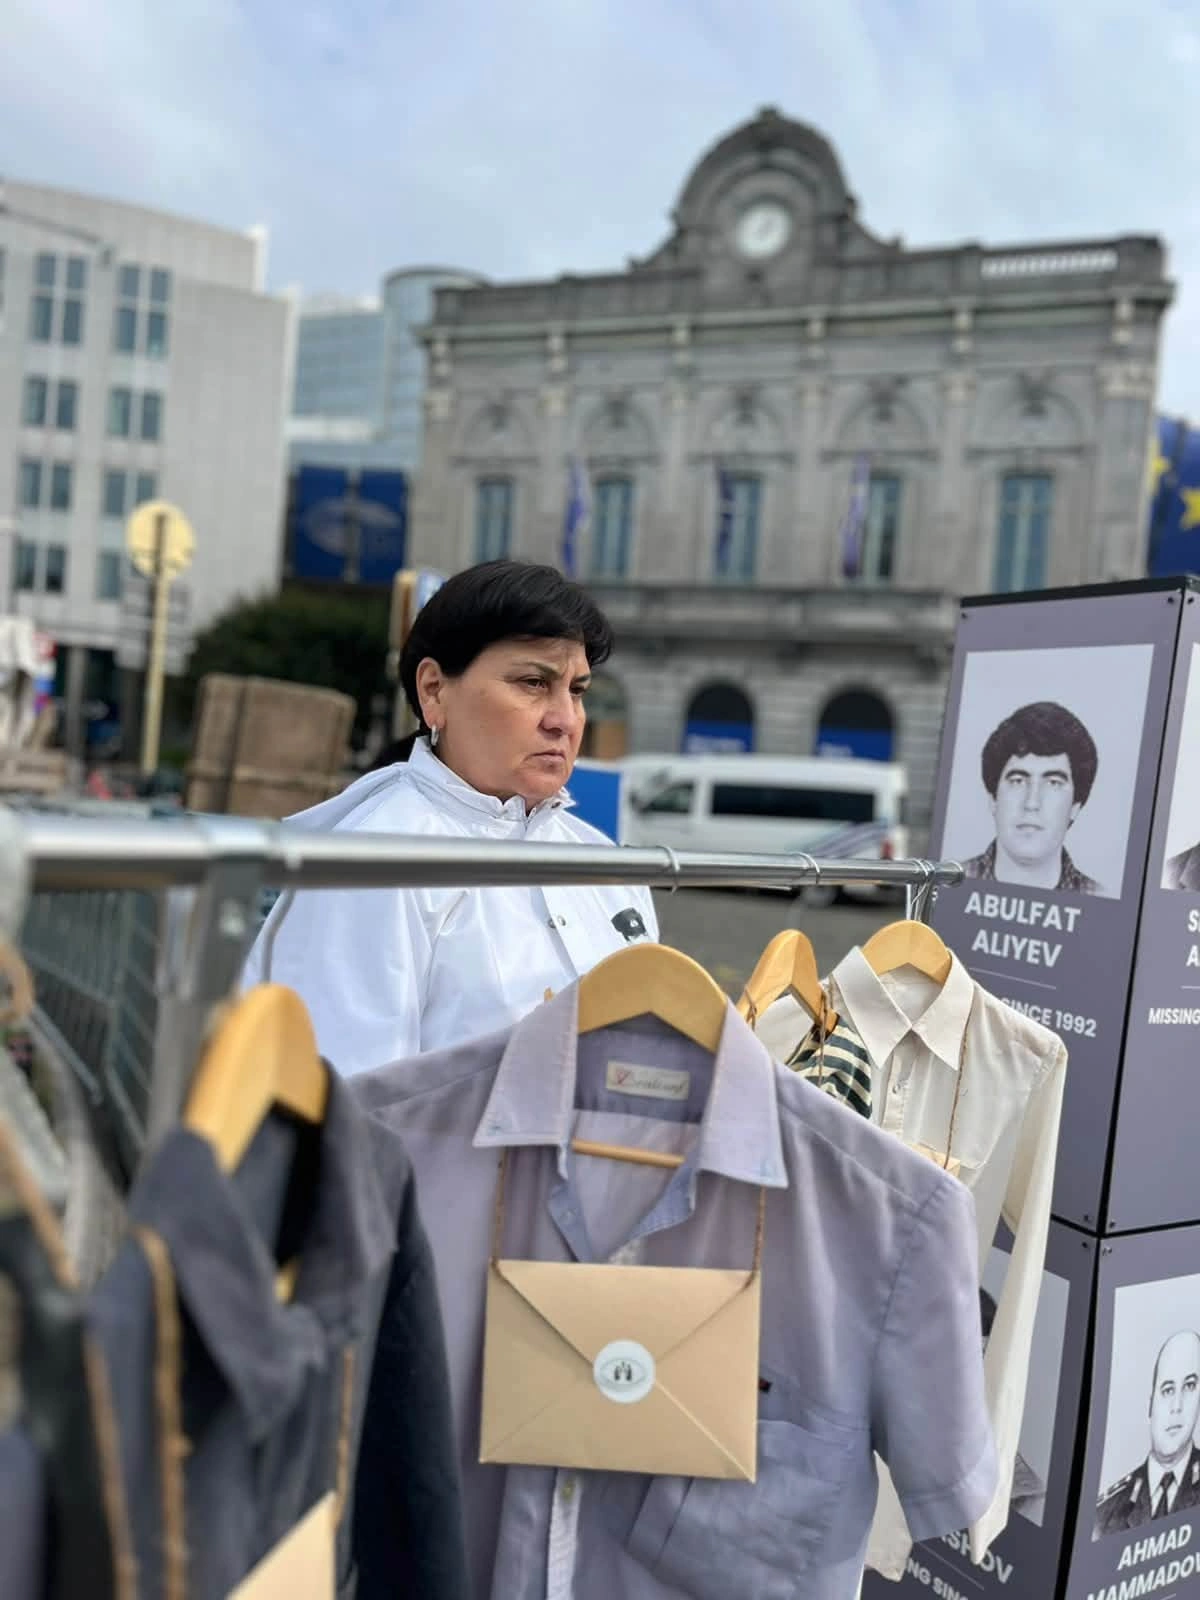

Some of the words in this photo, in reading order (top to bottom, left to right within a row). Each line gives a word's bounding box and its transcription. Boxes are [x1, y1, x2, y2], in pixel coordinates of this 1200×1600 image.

[964, 891, 1081, 933] ABULFAT
[1188, 909, 1200, 932] S
[972, 929, 1062, 967] ALIYEV
[1186, 945, 1200, 967] A
[1055, 1010, 1097, 1038] 1992
[1117, 1523, 1192, 1570] AHMAD
[932, 1577, 969, 1600] SIN
